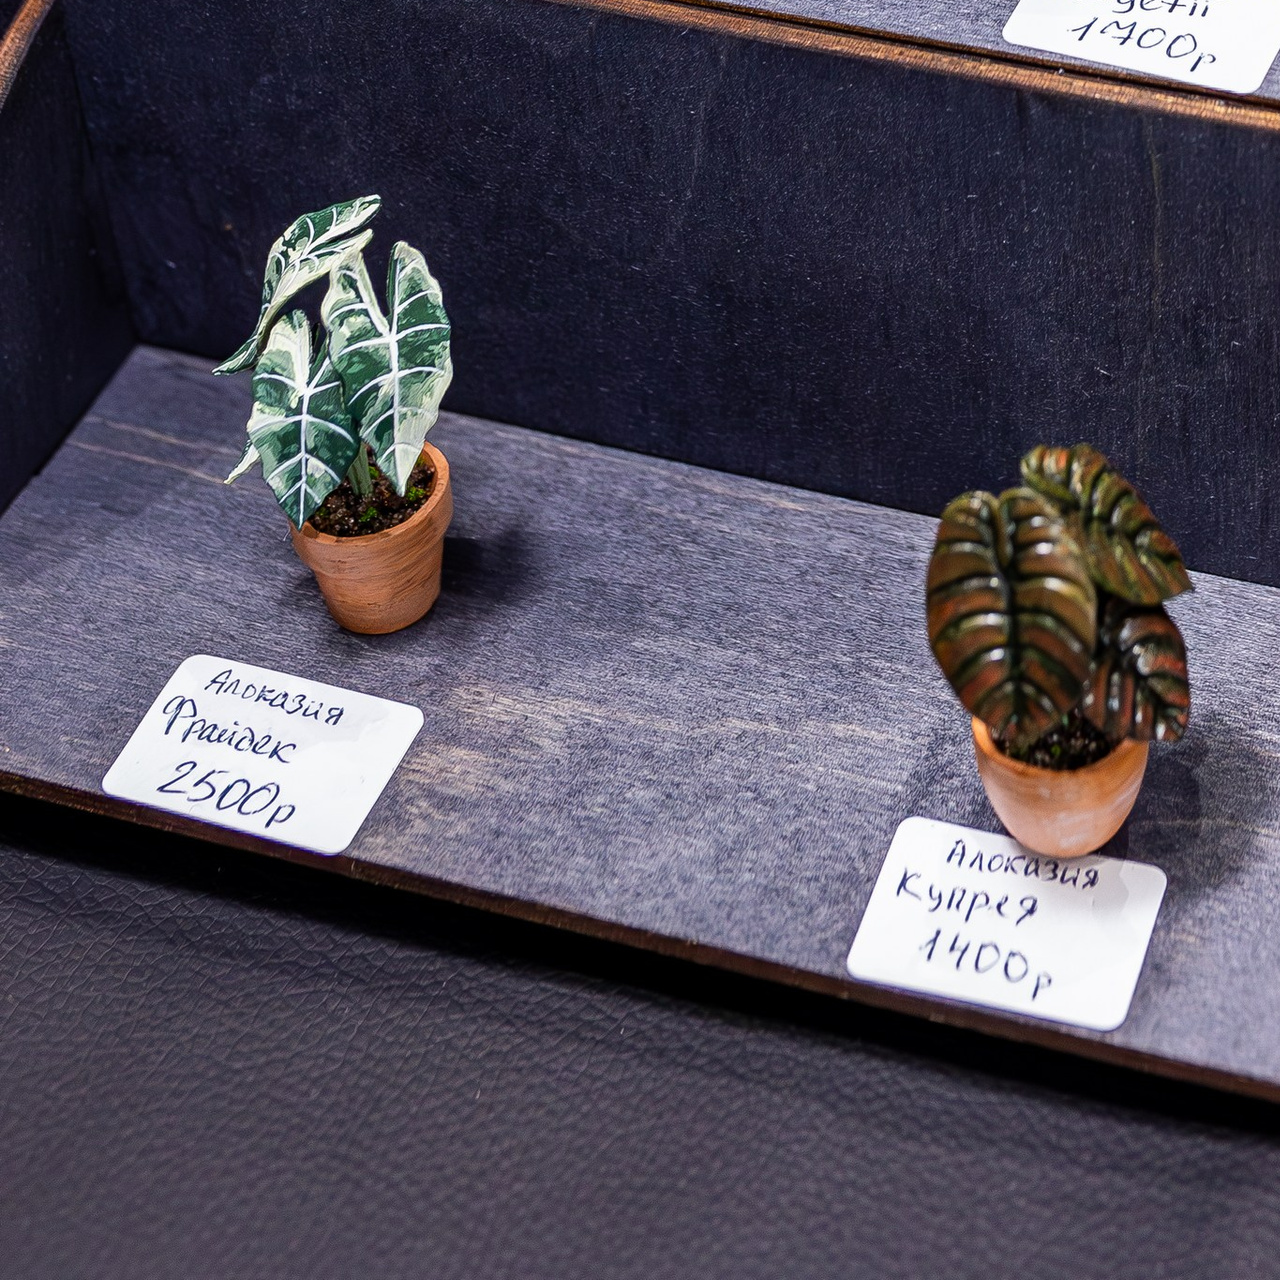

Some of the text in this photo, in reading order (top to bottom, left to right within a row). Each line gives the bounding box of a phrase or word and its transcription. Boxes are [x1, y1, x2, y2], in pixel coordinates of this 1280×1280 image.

[162, 695, 297, 764] Фрайдек
[204, 669, 345, 726] Алоказия
[156, 760, 296, 829] 2500р
[946, 839, 1100, 890] Алоказия
[896, 868, 1039, 927] Купрея
[918, 929, 1053, 1001] 1400р
